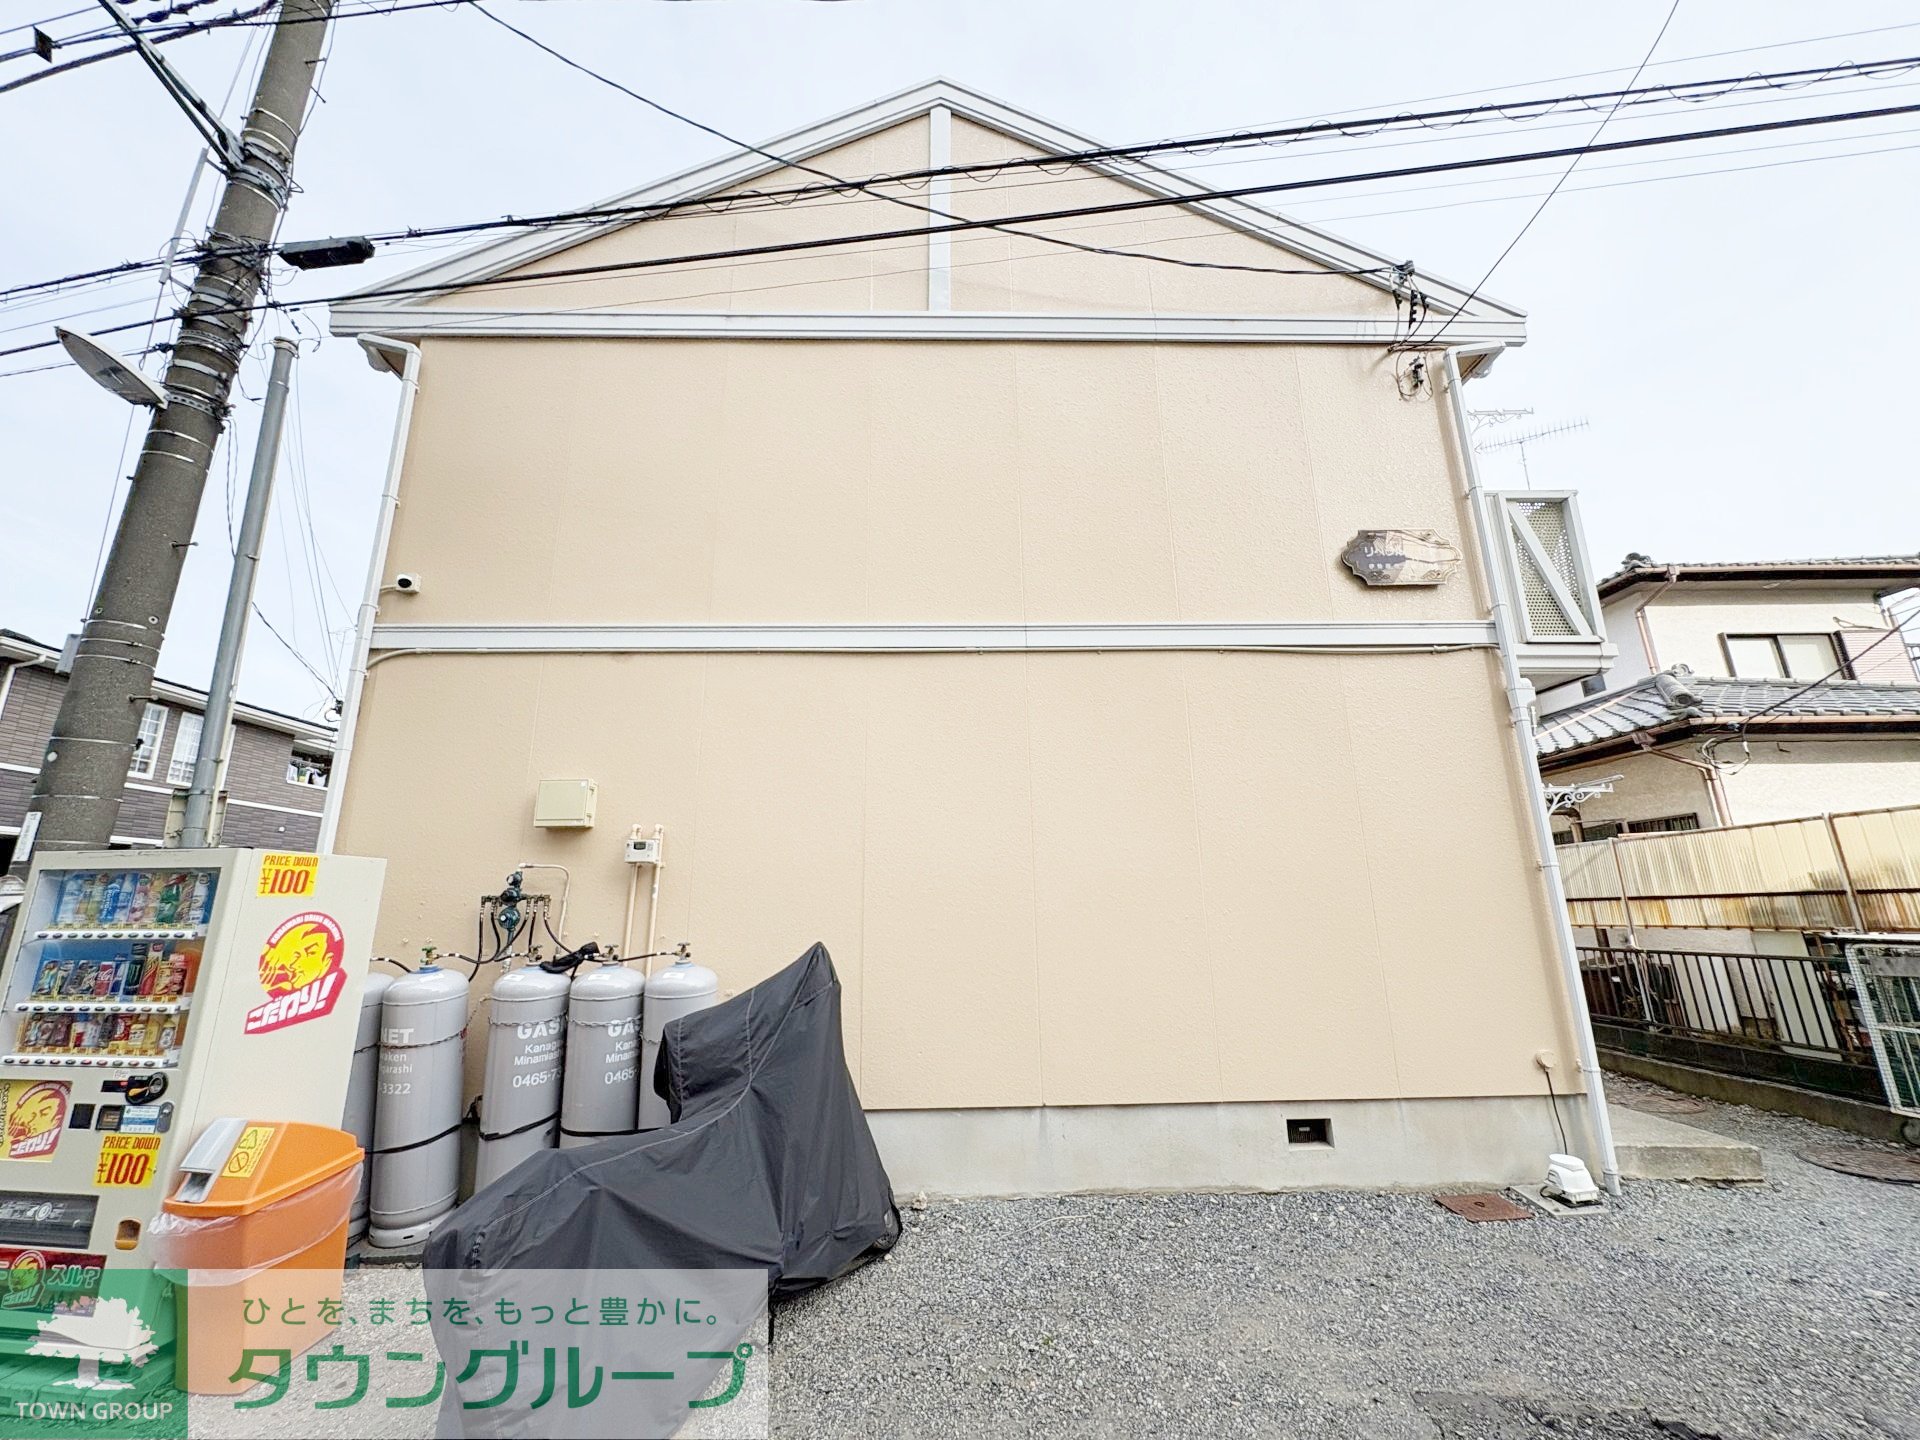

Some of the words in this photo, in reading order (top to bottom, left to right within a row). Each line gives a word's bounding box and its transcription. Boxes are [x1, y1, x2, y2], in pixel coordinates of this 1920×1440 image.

[263, 855, 291, 866] PRICE
[292, 857, 319, 867] DOWN
[103, 1136, 132, 1149] PRICE
[132, 1137, 161, 1150] DOWN
